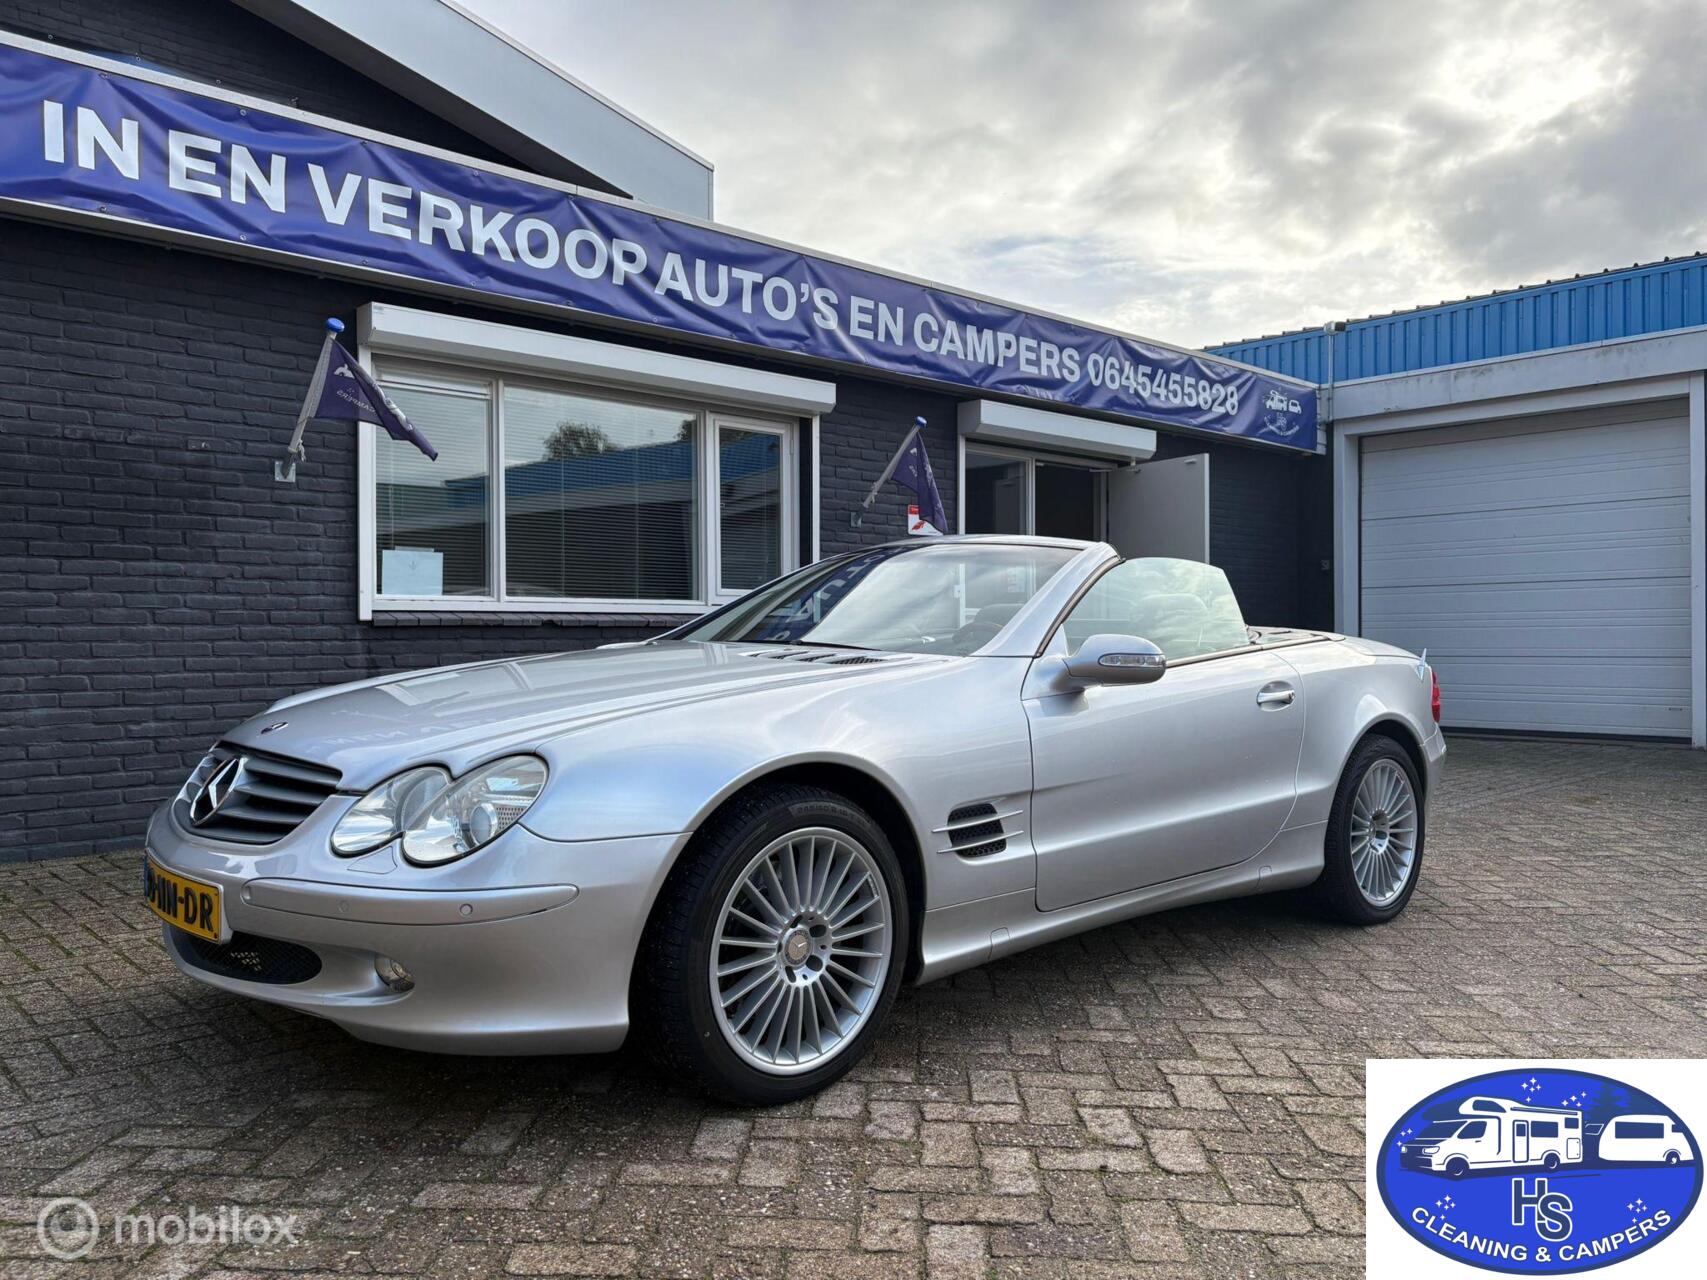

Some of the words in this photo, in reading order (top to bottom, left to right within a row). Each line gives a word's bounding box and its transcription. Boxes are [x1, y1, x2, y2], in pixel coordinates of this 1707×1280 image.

[43, 100, 140, 180] IN
[168, 130, 287, 213] EN
[308, 163, 648, 285] VERKOOP
[655, 252, 838, 330] AUTO'S
[851, 296, 904, 345] EN
[914, 312, 1080, 383] CAMPERS
[1087, 352, 1239, 416] 0645455828
